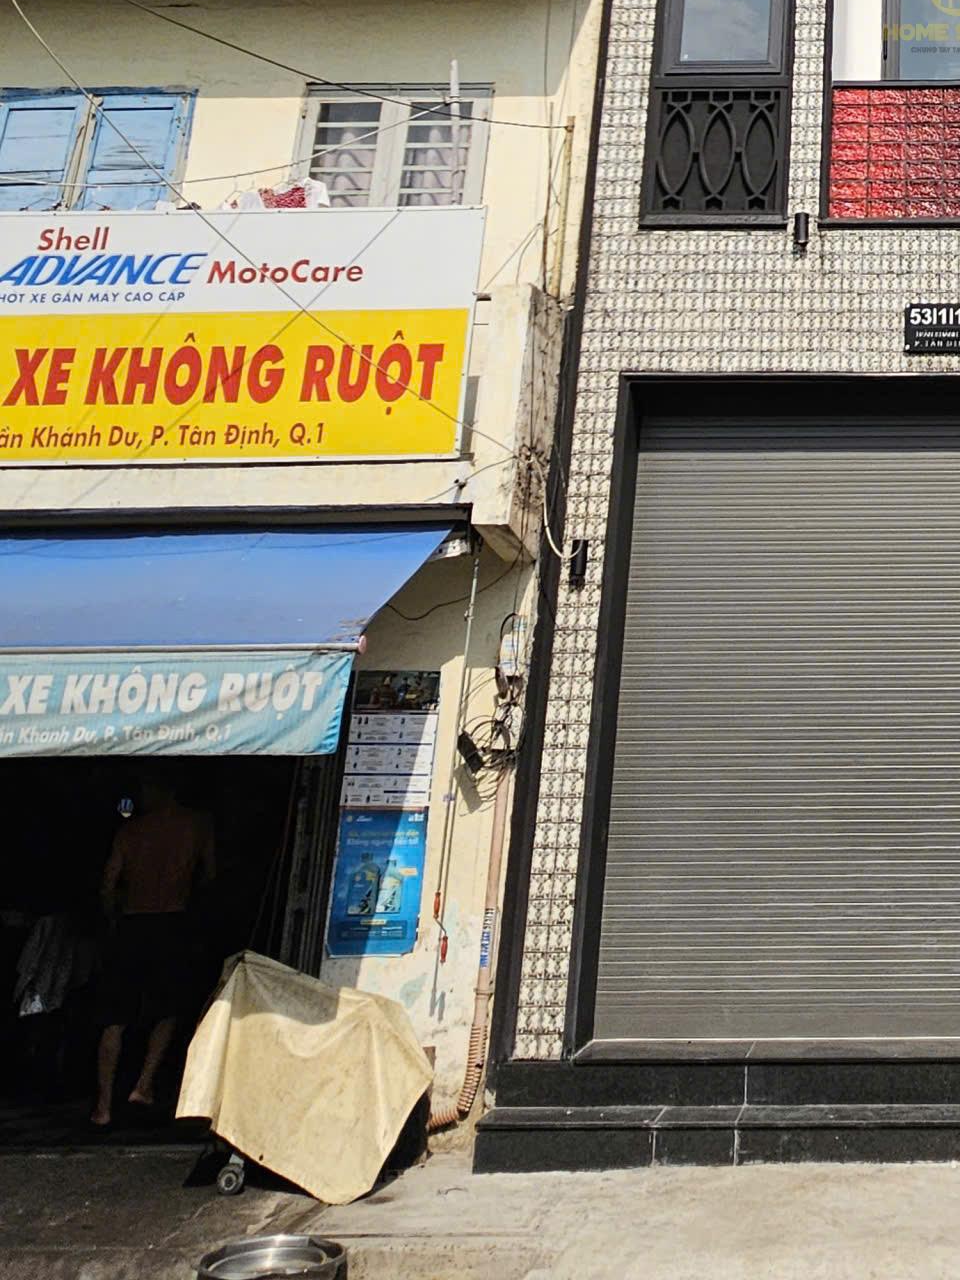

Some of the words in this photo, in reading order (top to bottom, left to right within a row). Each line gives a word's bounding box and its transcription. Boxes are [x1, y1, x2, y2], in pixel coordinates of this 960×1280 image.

[37, 227, 110, 251] Shell
[0, 251, 209, 286] ADVANCE
[207, 259, 363, 284] MotoCare
[30, 292, 47, 304] XE
[124, 291, 153, 303] CAO
[2, 348, 76, 406] XE
[84, 332, 285, 406] KHÔNG
[299, 329, 445, 416] RUỘT
[31, 425, 101, 449] Khánh
[150, 425, 169, 447] P.
[179, 424, 216, 446] Tân
[224, 422, 280, 450] Định,
[289, 422, 324, 447] Q.1
[0, 674, 54, 715] XE
[60, 665, 207, 715] KHÔNG
[218, 663, 324, 721] RUỘT
